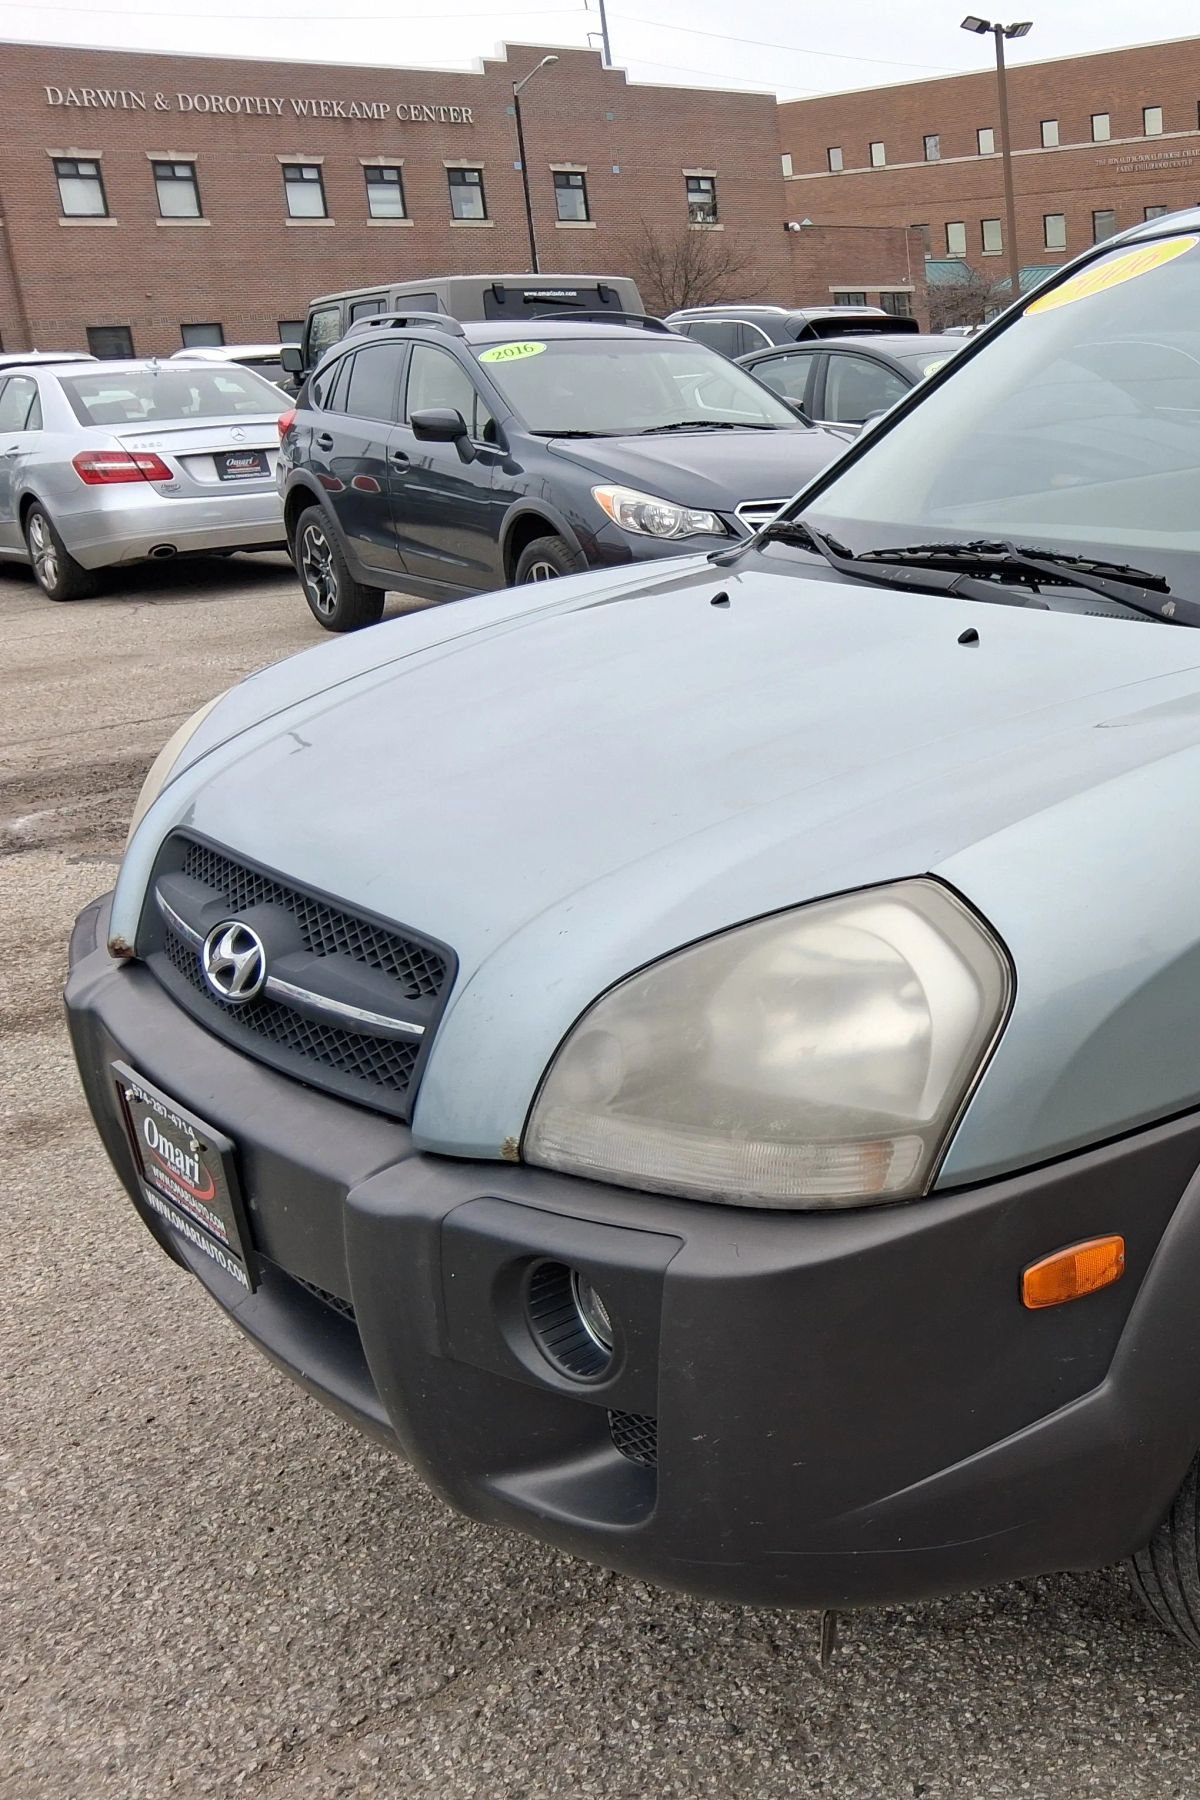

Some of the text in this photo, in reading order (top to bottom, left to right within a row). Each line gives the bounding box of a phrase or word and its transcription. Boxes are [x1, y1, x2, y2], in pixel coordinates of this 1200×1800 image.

[44, 86, 474, 124] DARWIN & DOROTHY WIEKAMP CENTER
[492, 343, 534, 361] 2016
[143, 1116, 200, 1184] Omari
[145, 1188, 250, 1291] WWW.OMARIAUTO.COM
